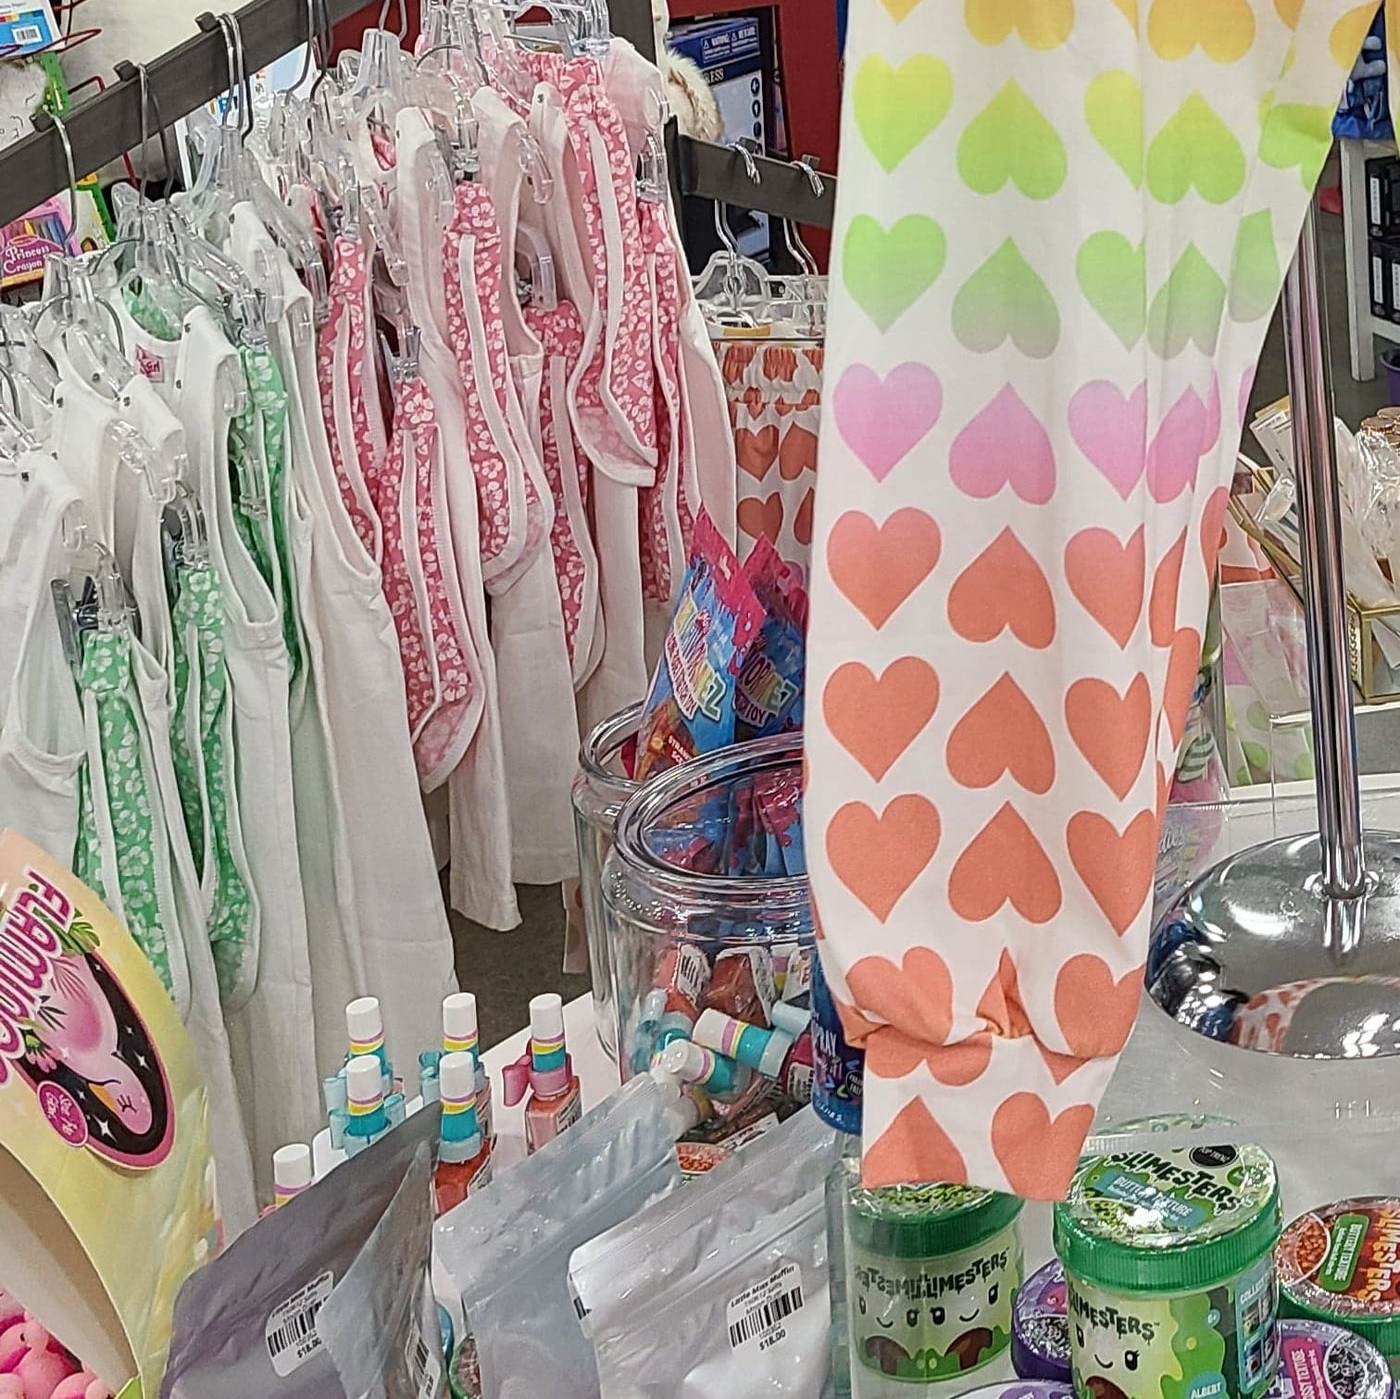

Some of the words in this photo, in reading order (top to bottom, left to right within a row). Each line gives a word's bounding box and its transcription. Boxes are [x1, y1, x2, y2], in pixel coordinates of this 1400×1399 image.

[1104, 1151, 1241, 1215] SLIMESTERS
[731, 1290, 750, 1308] Little
[752, 1281, 769, 1294] Miss
[769, 1265, 795, 1283] Muffin
[925, 1250, 1008, 1300] LIMESTERS
[759, 1328, 787, 1351] $18.00
[1191, 1381, 1222, 1399] ALBERT
